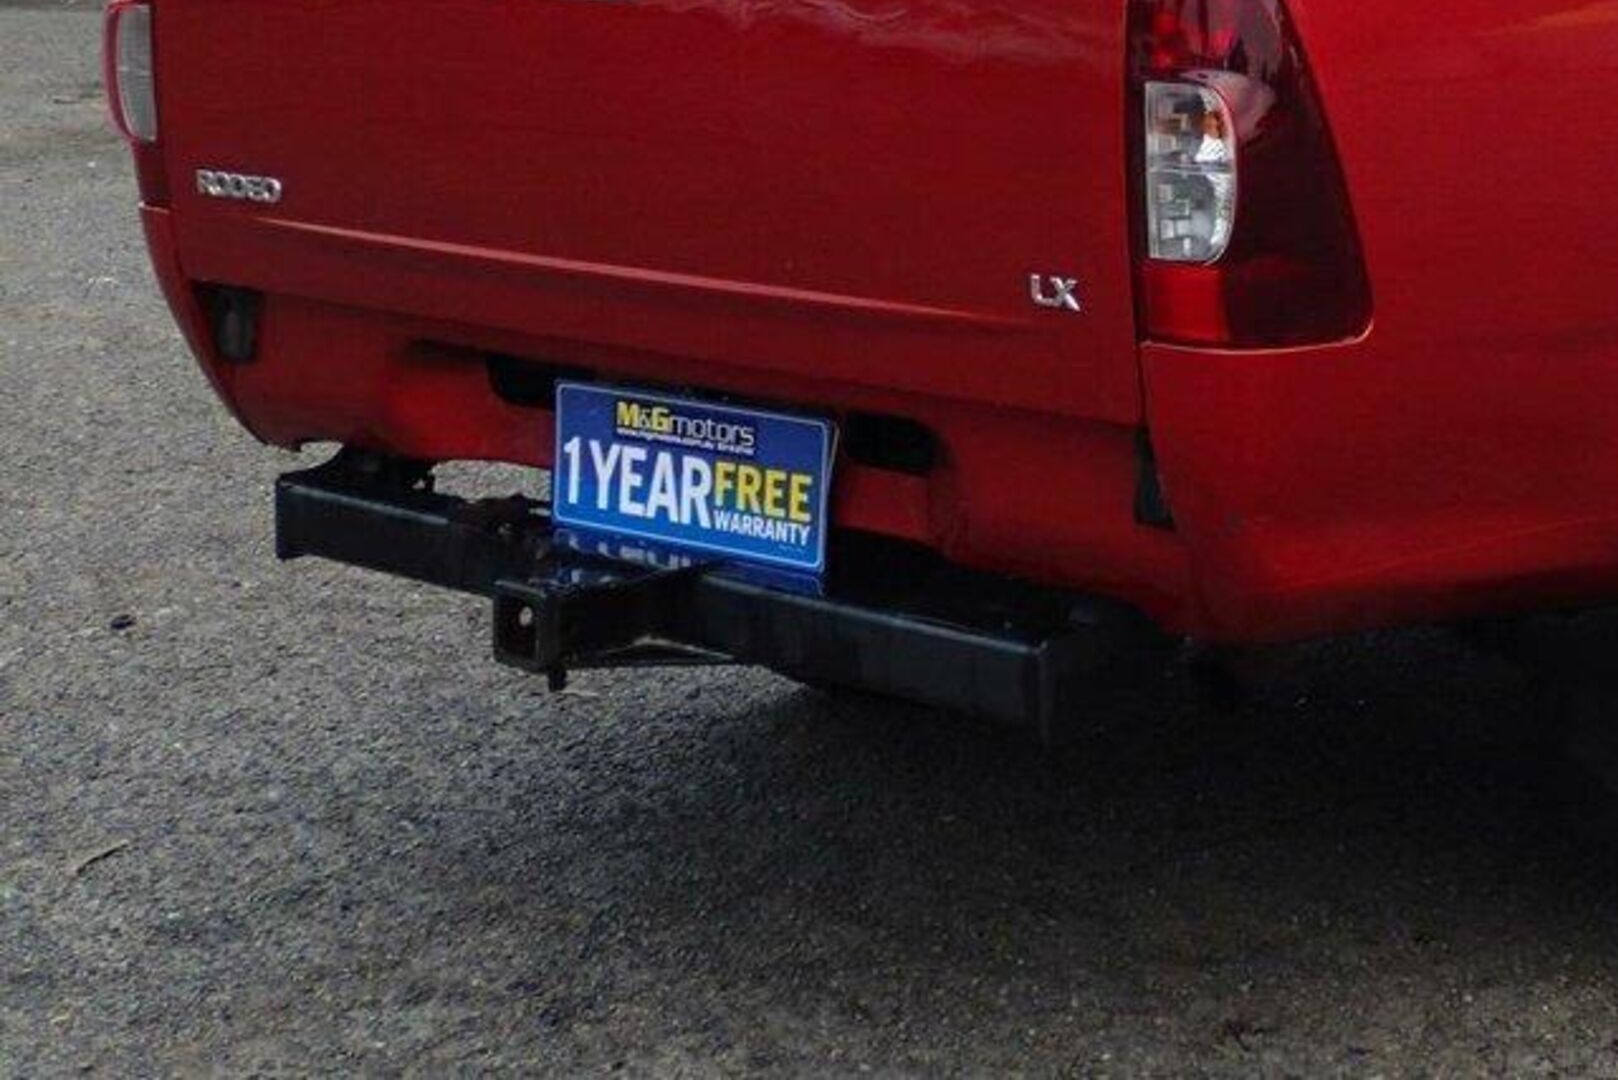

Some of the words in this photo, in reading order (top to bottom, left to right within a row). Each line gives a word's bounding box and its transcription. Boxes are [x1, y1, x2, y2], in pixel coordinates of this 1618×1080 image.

[196, 169, 283, 204] RODEO
[1031, 273, 1081, 311] LX
[563, 436, 579, 505] 1
[588, 439, 711, 529] YEAR
[714, 461, 812, 524] FREE
[713, 509, 811, 547] WARRANTY
